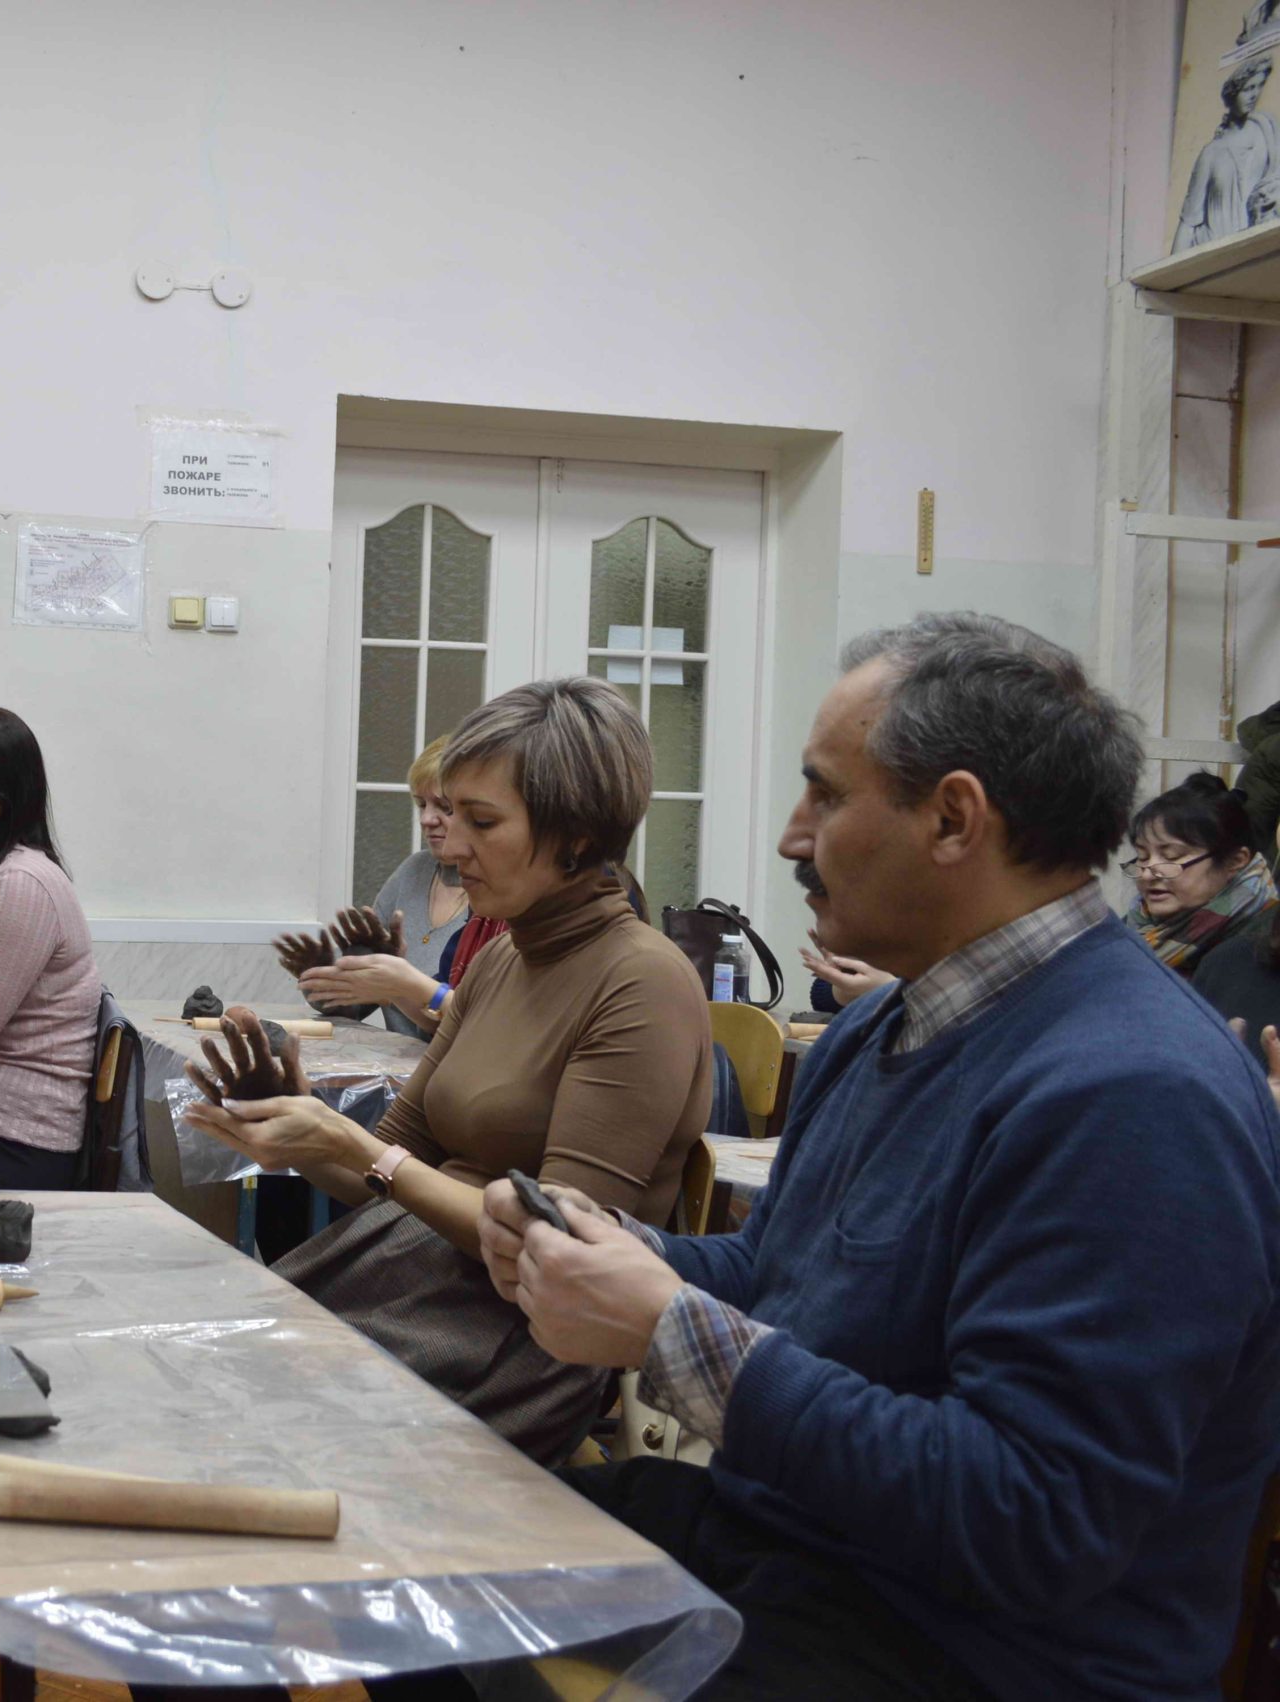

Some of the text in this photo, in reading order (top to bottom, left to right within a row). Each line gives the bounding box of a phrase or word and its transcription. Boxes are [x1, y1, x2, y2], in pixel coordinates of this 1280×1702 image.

[182, 455, 208, 465] ПРИ
[168, 470, 221, 481] ПОЖАРЕ
[163, 485, 226, 497] ЗВОНИТЬ:
